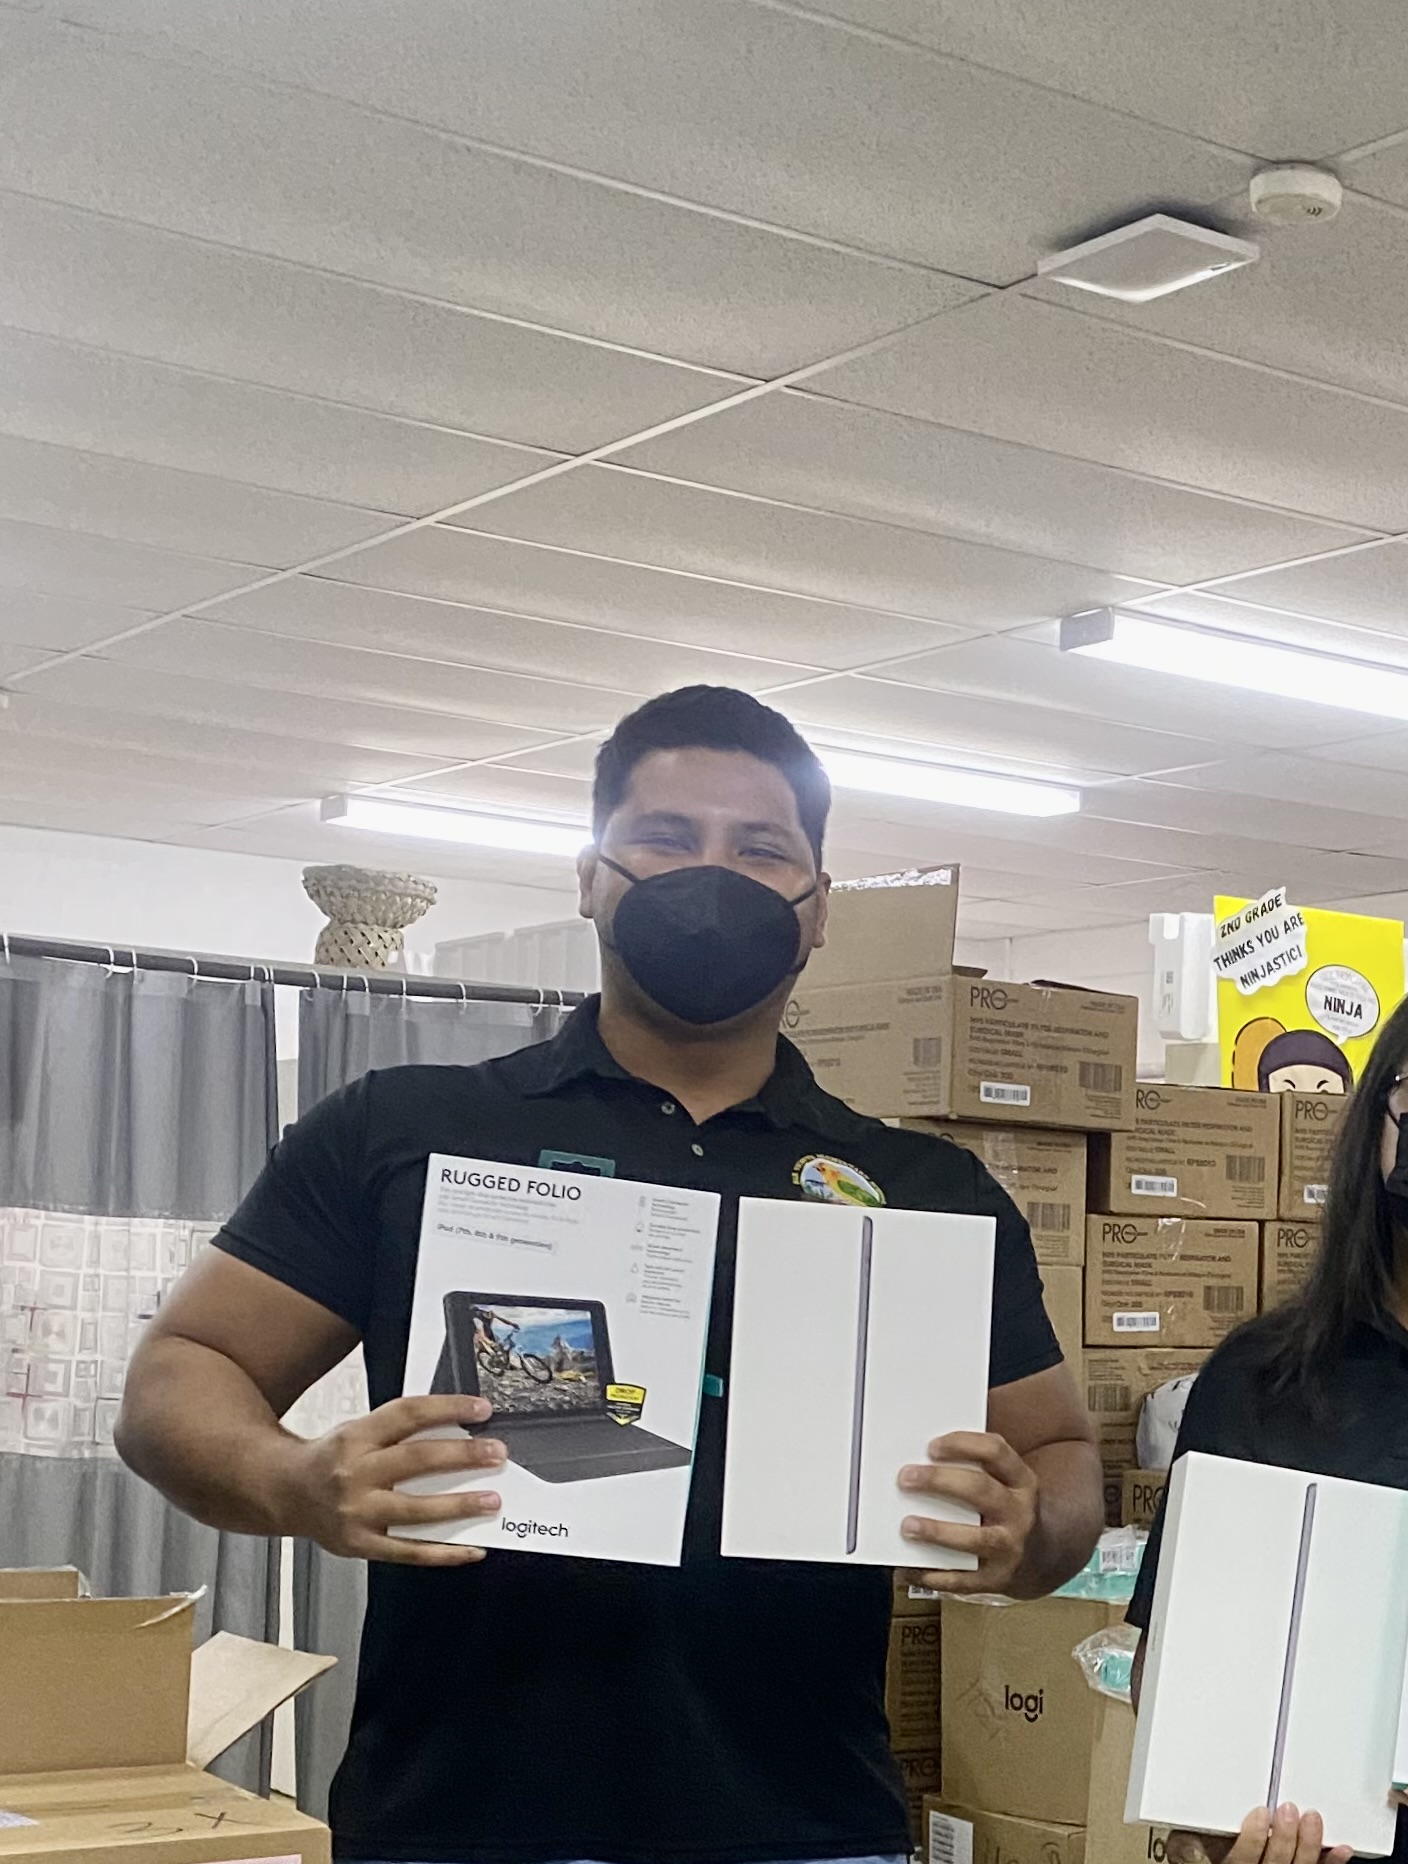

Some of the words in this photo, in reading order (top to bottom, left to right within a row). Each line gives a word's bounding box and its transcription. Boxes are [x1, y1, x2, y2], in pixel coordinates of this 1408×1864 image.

[1245, 893, 1282, 923] GRADE
[1213, 940, 1255, 971] THINKS
[1257, 926, 1280, 948] YOU
[1284, 912, 1305, 934] ARE
[970, 986, 1009, 1010] PRO
[1324, 995, 1363, 1020] NINJA
[1136, 1089, 1161, 1110] RO
[1295, 1100, 1329, 1121] PRO
[440, 1168, 521, 1193] RUGGED
[527, 1180, 581, 1201] FOLIO
[1102, 1223, 1138, 1244] PRO
[1277, 1228, 1309, 1248] PRO
[501, 1517, 569, 1538] logitech
[1004, 1684, 1043, 1723] logi
